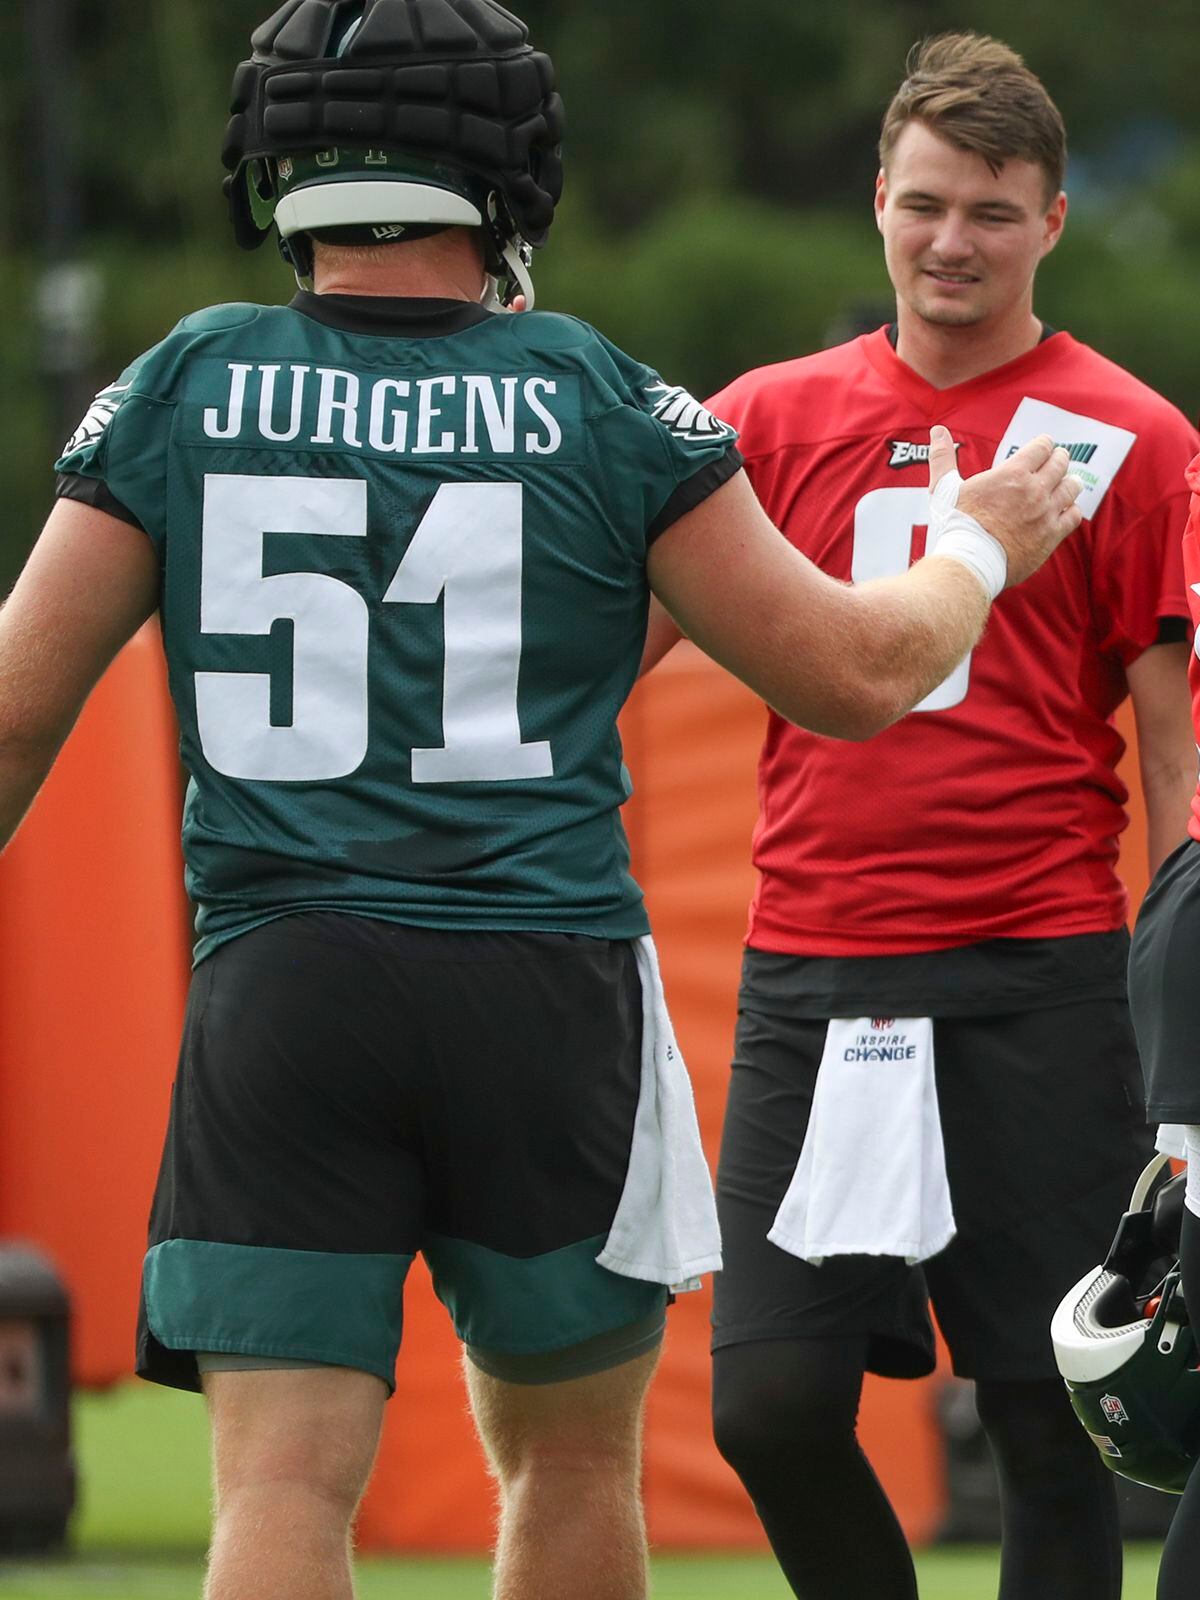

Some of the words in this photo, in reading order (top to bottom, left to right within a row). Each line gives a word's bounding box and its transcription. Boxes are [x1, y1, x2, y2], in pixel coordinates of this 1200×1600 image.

[202, 361, 563, 456] JURGENS
[195, 474, 554, 783] 51
[844, 1045, 917, 1063] CHANGE
[856, 1034, 907, 1046] INSPIRE
